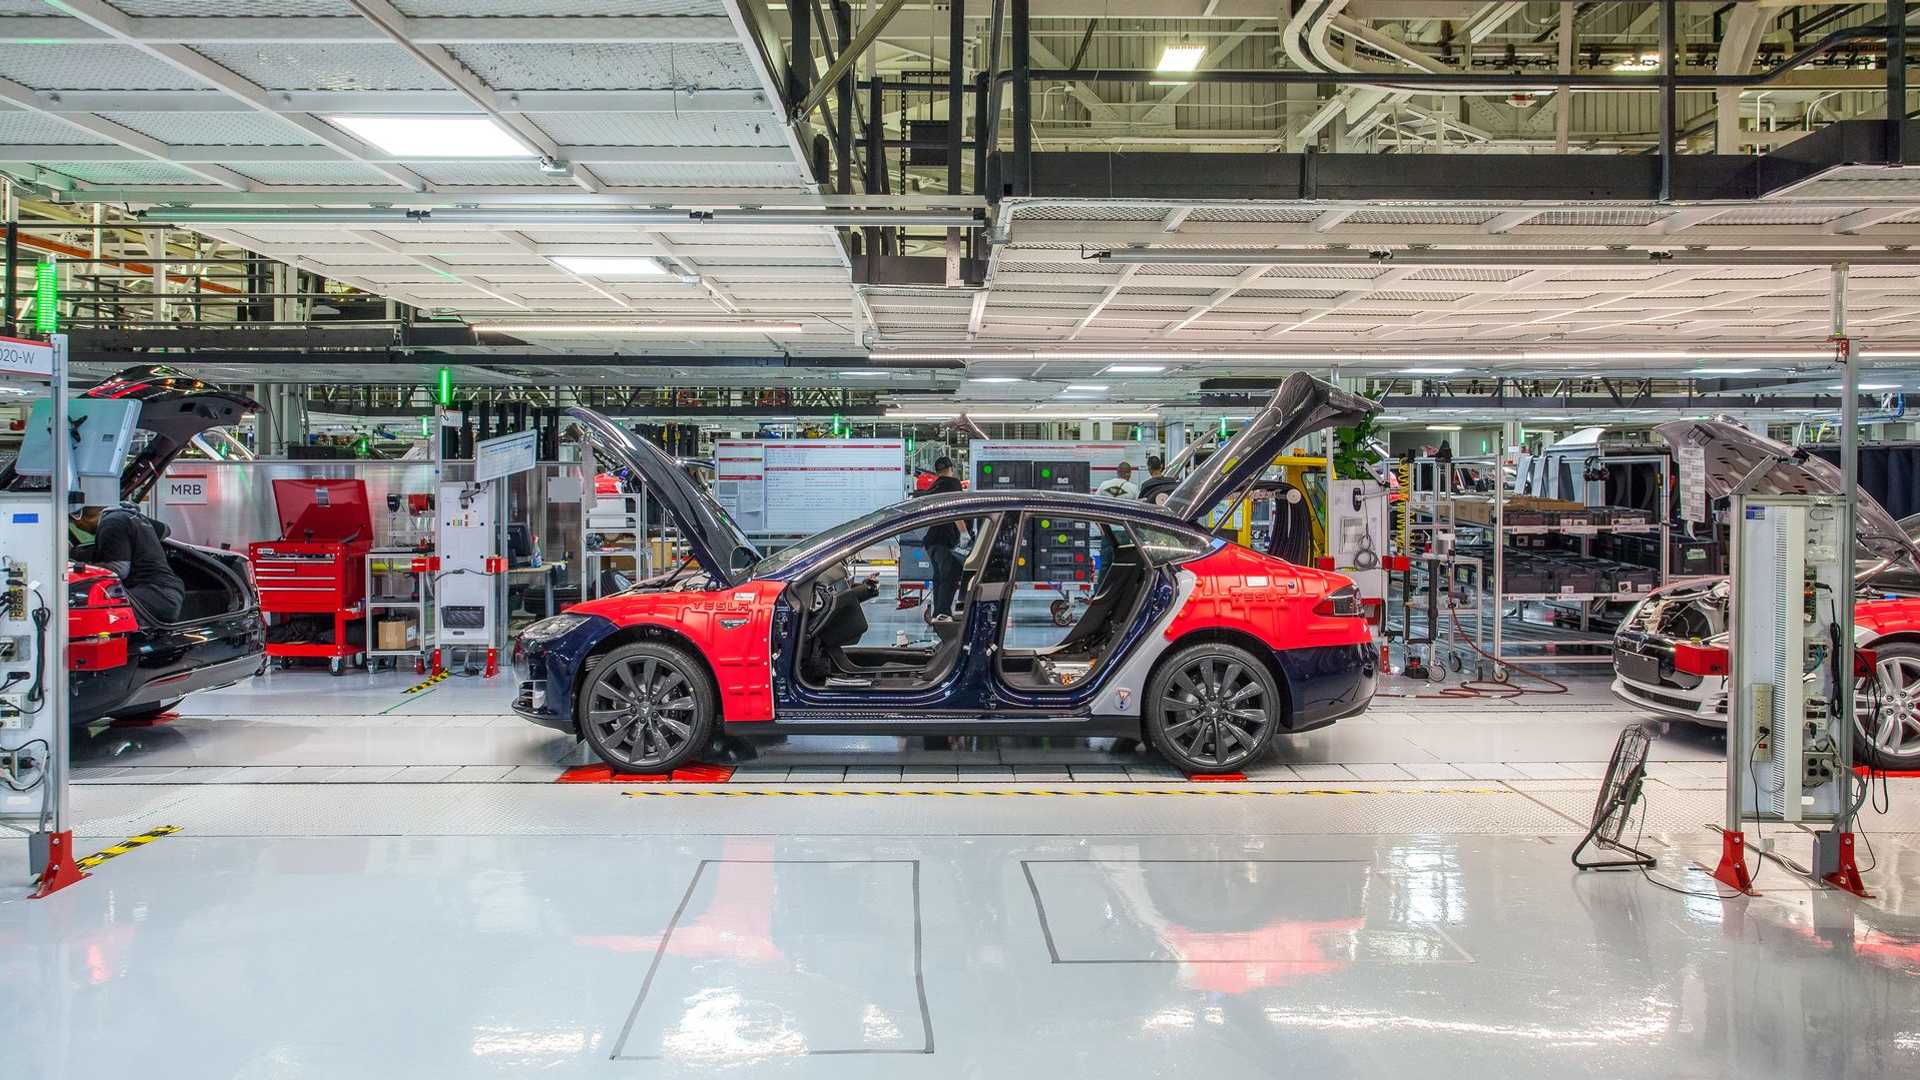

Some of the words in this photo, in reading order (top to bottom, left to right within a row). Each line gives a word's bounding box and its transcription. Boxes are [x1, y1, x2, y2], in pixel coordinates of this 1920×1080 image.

[171, 484, 202, 495] MRB
[1231, 592, 1287, 602] TESLA
[693, 601, 749, 611] TESLA
